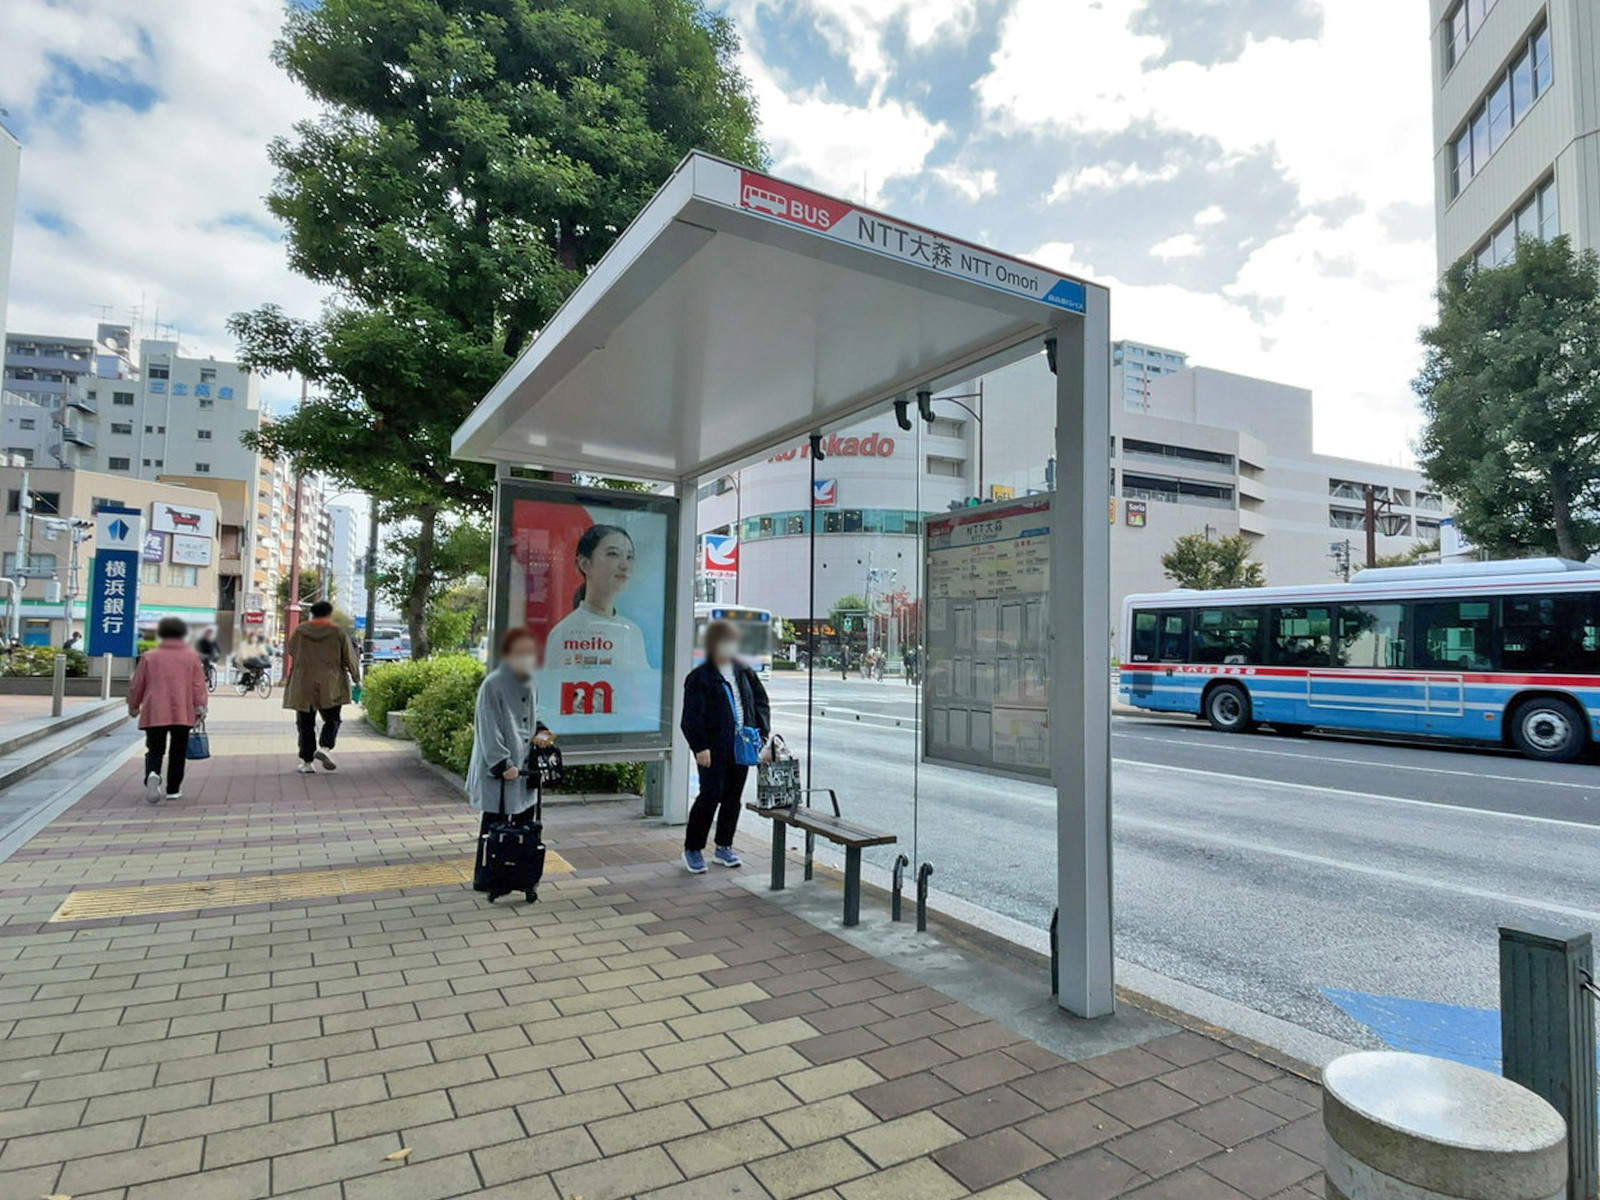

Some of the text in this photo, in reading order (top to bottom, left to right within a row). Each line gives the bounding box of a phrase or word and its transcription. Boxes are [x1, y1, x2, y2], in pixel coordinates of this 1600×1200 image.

[791, 200, 830, 228] BUS
[858, 216, 1039, 292] NTT大森 NTT Omori
[801, 432, 895, 458] kado
[102, 560, 127, 634] 横浜銀行
[564, 637, 614, 651] meito
